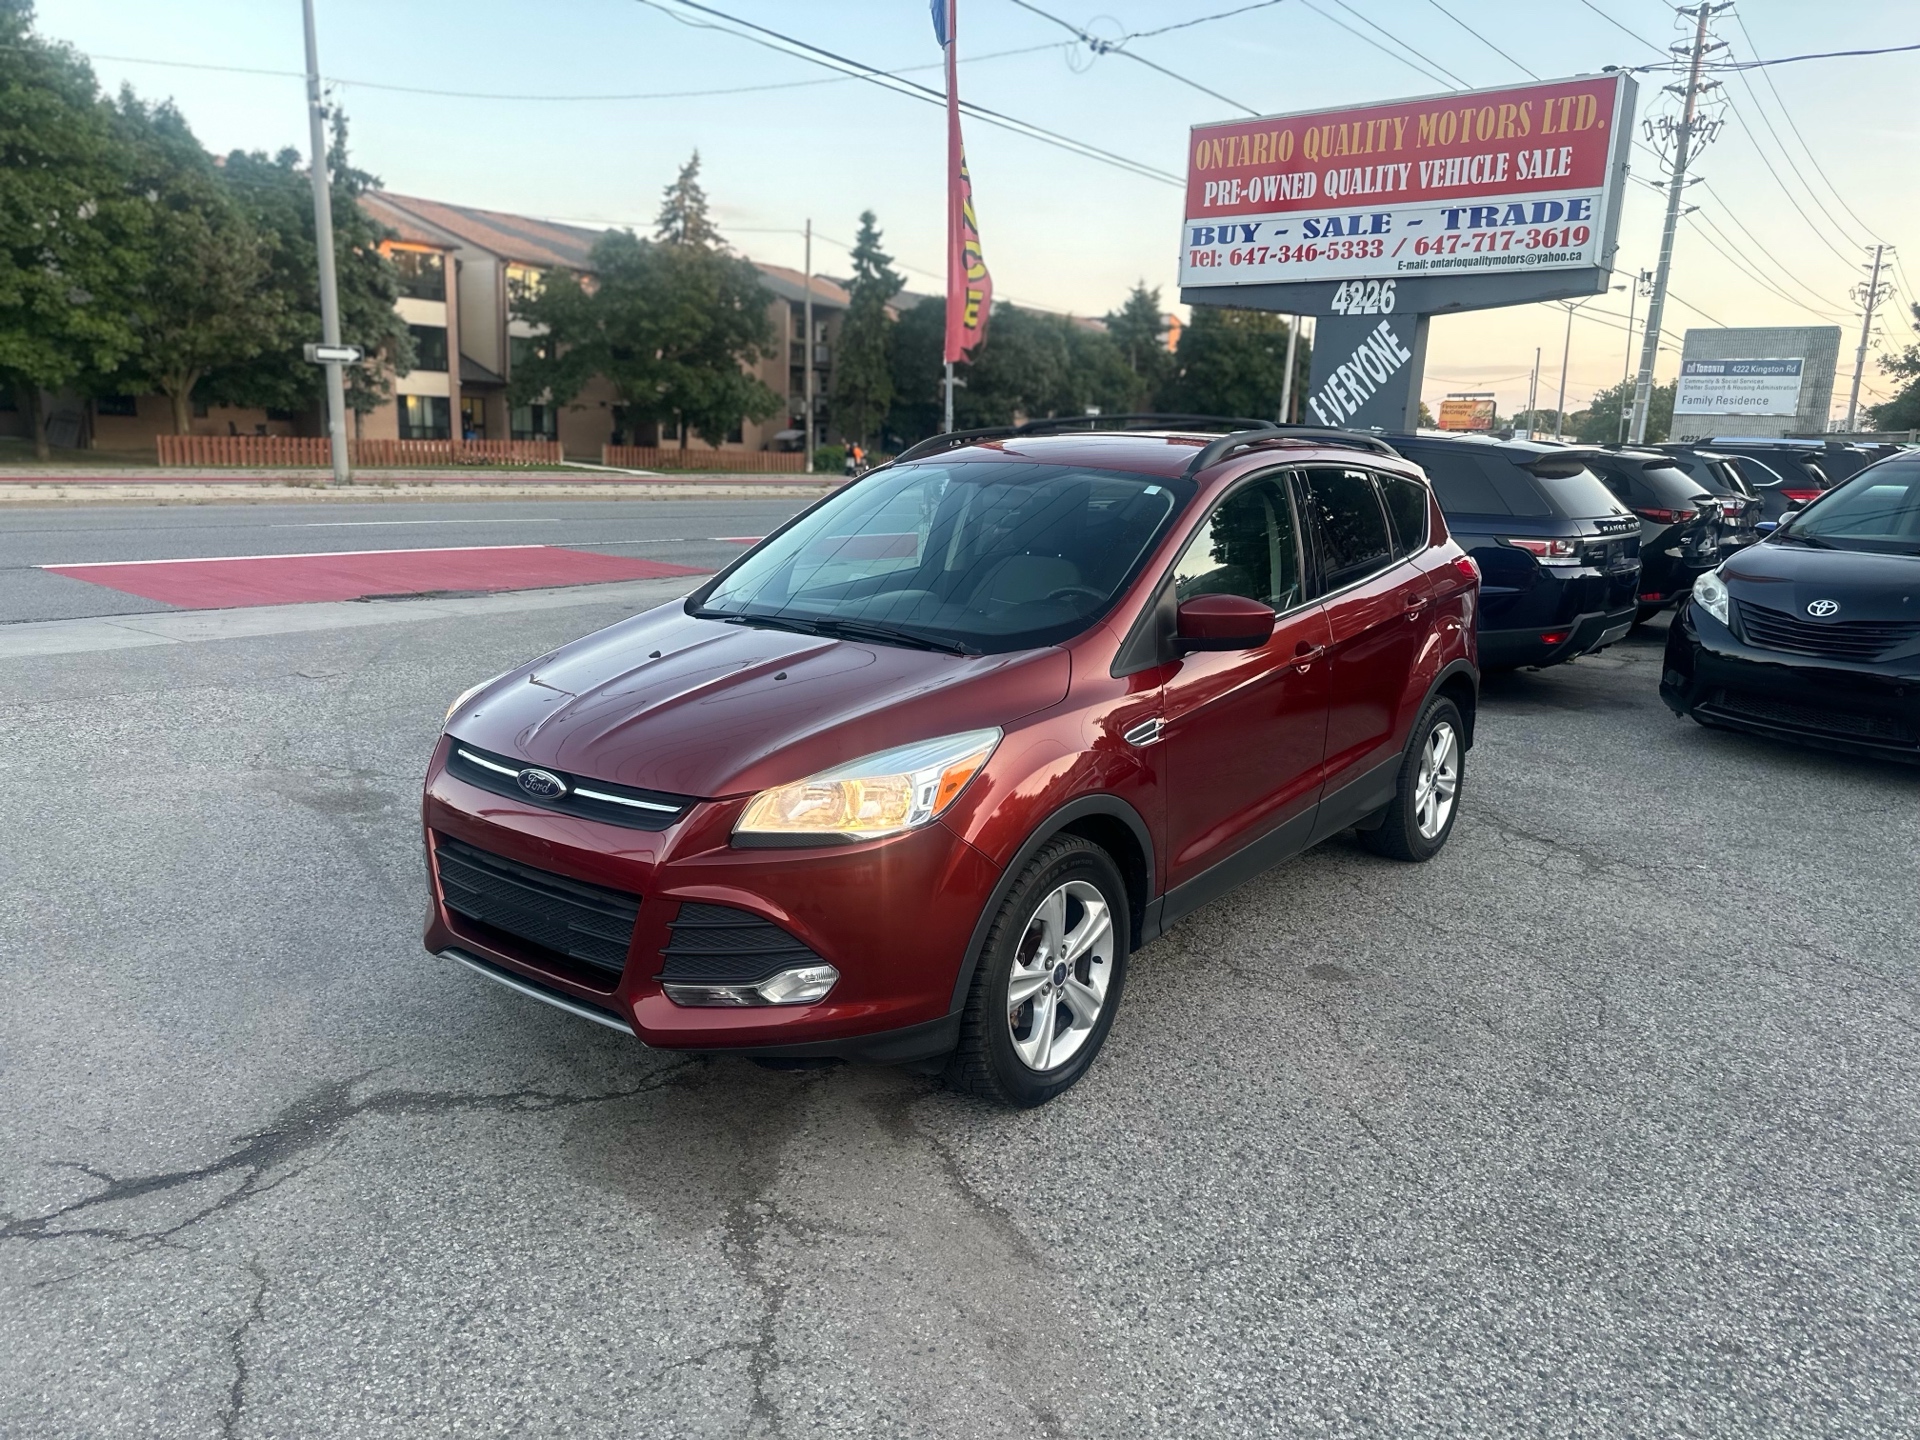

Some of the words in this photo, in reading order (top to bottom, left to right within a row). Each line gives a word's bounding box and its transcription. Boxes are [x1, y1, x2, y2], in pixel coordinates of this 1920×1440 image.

[1196, 129, 1295, 171] ONTARIO
[1303, 116, 1410, 163] QUALITY
[1416, 101, 1533, 149] MOTORS
[1540, 94, 1605, 136] LTD.
[1203, 172, 1318, 207] PRE-OWNED
[1324, 162, 1412, 199] QUALITY
[1419, 152, 1510, 189] VEHICLE
[1516, 146, 1573, 181] SALE
[1190, 223, 1262, 247] BUY
[1302, 213, 1392, 240] SALE
[1407, 219, 1423, 227] -
[1440, 198, 1592, 231] TRADE
[1189, 249, 1223, 268] Tel:
[1229, 239, 1384, 267] 647-346-5333
[1391, 237, 1408, 258] /
[1414, 225, 1591, 256] 647-717-3619
[1397, 259, 1429, 271] E-mail:
[1430, 251, 1582, 269] ontarioqualitymotors@yahoo.ca
[1331, 279, 1397, 315] 4226
[1309, 319, 1412, 427] EVERYONE
[1731, 365, 1750, 373] 4222
[1750, 364, 1785, 374] Kingston
[1785, 364, 1798, 373] Rd
[1681, 395, 1714, 407] Family
[1715, 395, 1770, 406] Residence
[1704, 384, 1726, 392] Support
[1732, 384, 1755, 392] Housing
[525, 773, 551, 794] Ford
